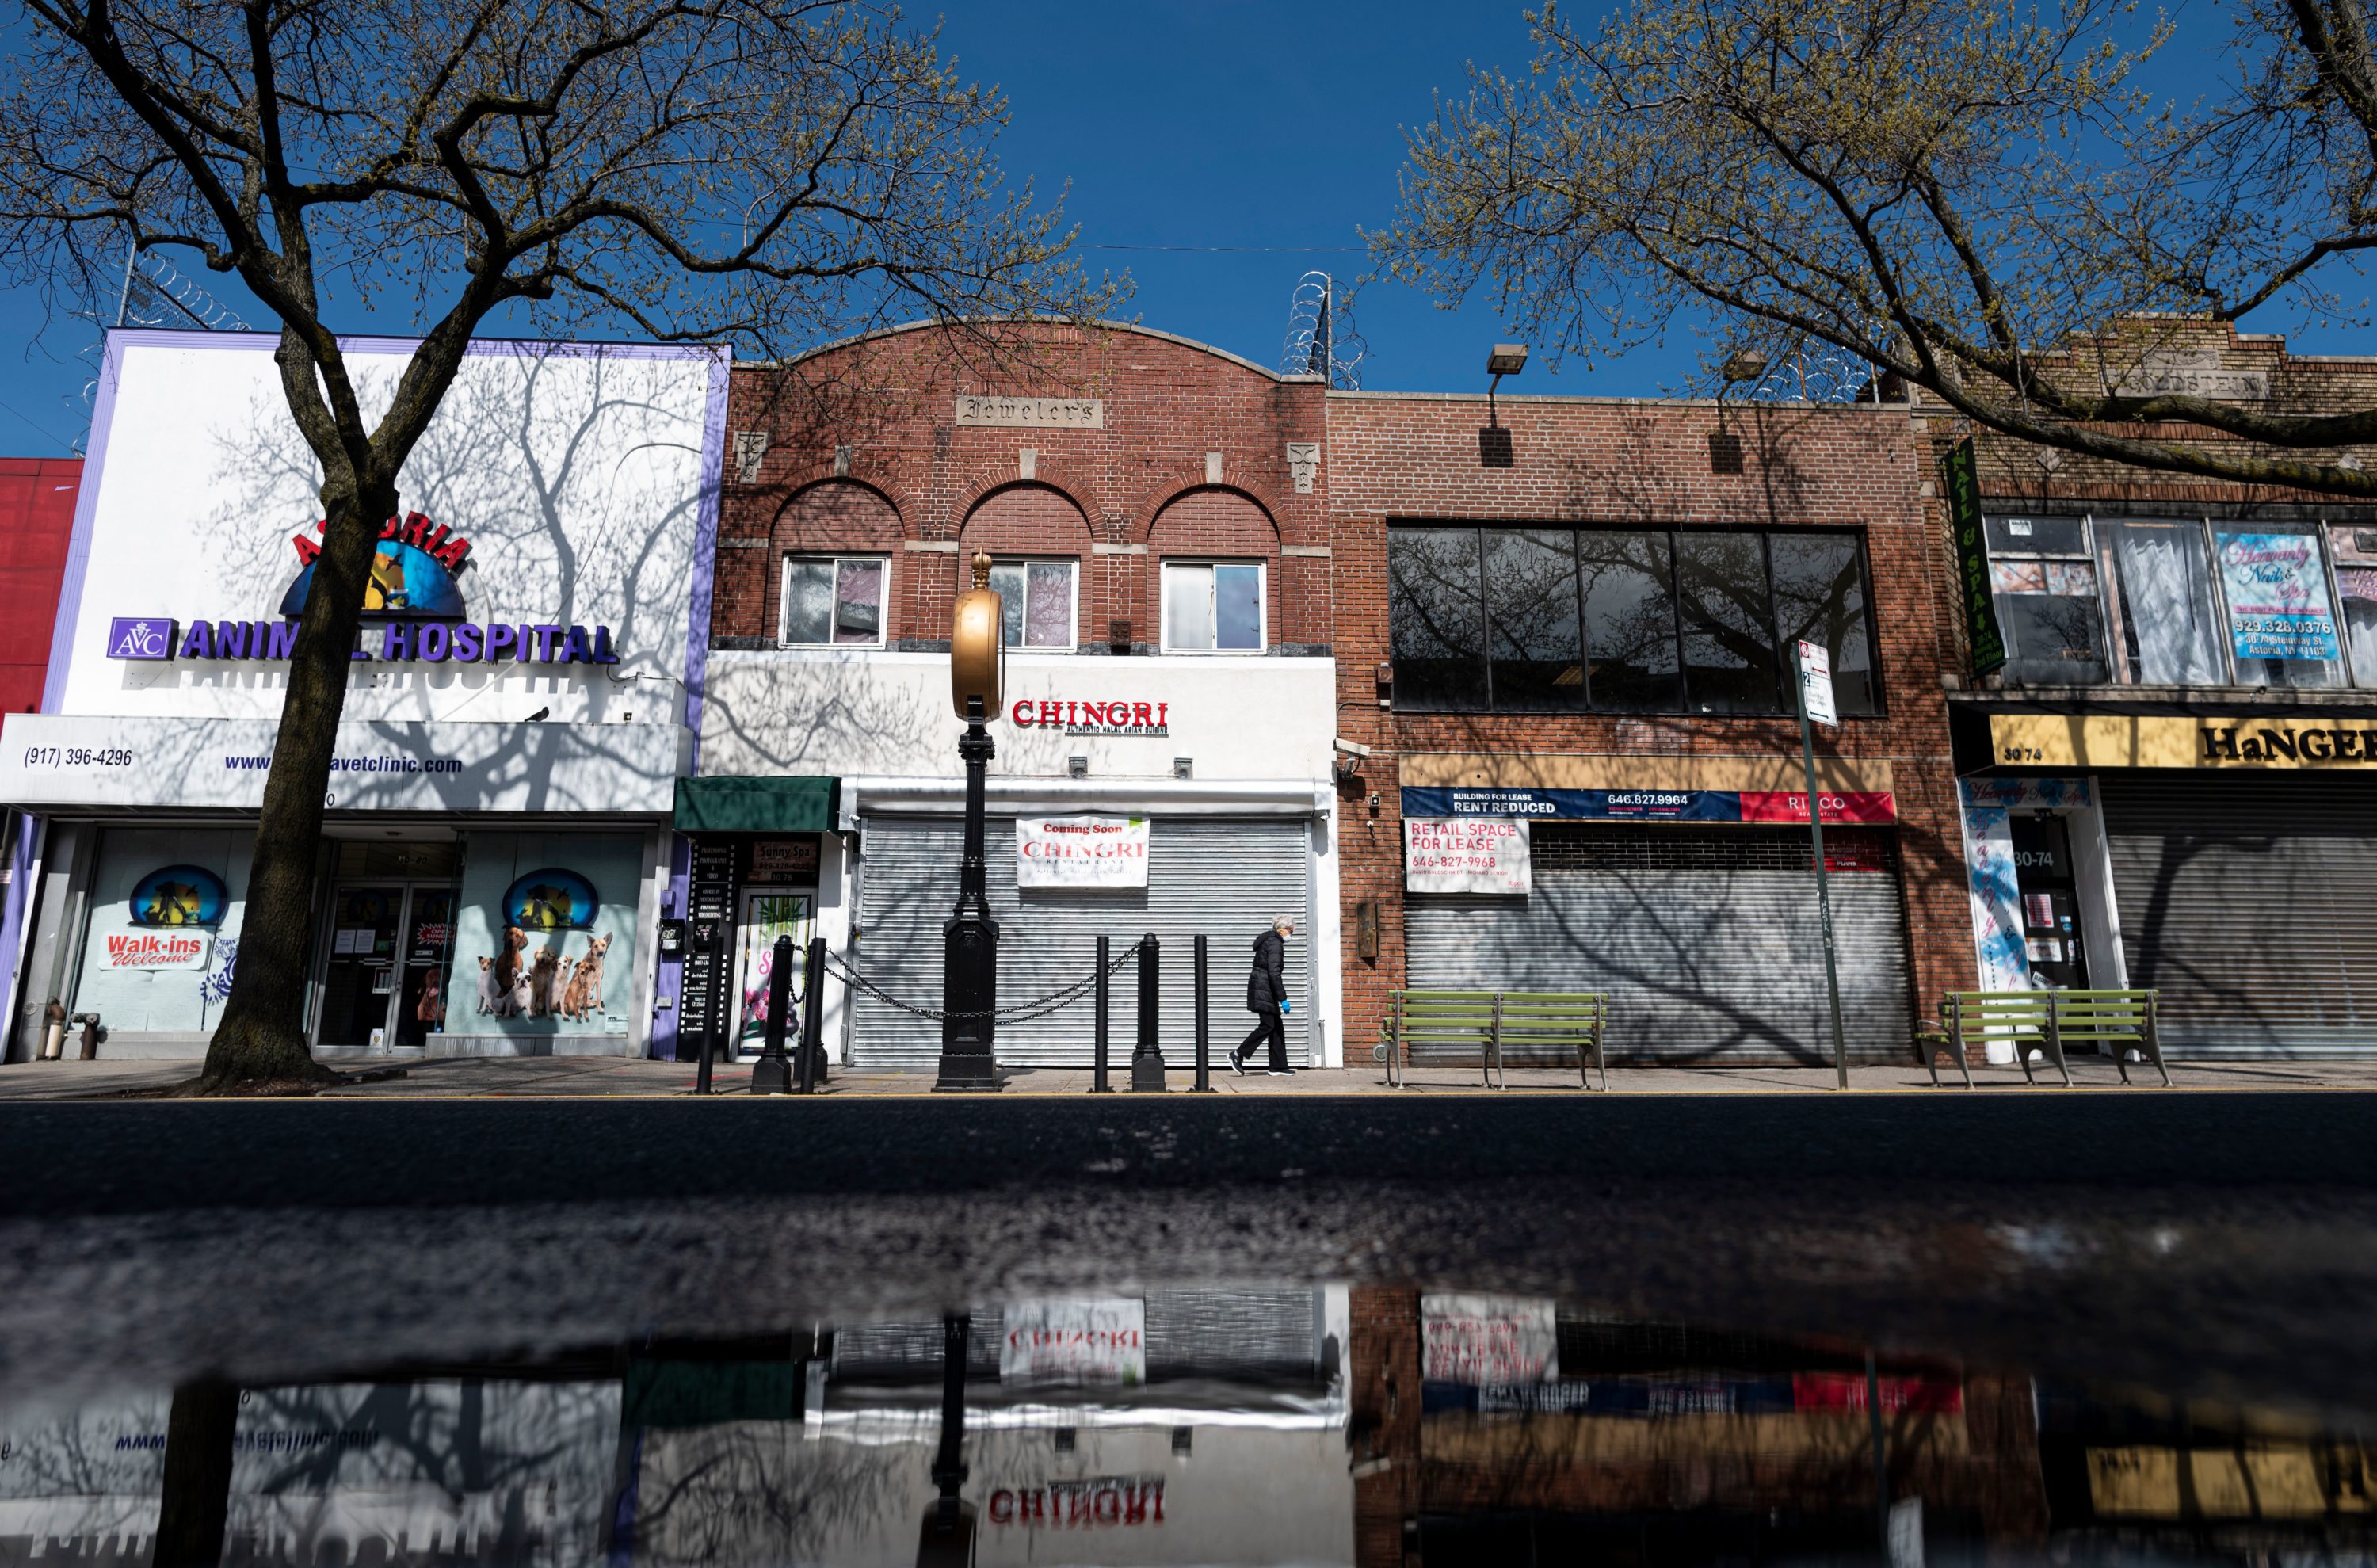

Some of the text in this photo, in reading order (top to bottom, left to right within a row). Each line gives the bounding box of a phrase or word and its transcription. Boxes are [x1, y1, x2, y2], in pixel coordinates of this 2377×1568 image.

[962, 399, 1093, 424] Jewelers
[1952, 449, 1973, 521] NAIL
[2225, 539, 2311, 570] Heavenly
[1967, 555, 1986, 612] SPA
[2276, 579, 2309, 607] Spa
[2234, 620, 2332, 635] 929.328.0376
[115, 628, 163, 655] AVC
[383, 622, 618, 664] HOSPITAL
[1013, 700, 1169, 727] CHINGRI
[25, 746, 132, 769] (917) 396-4296
[1453, 802, 1489, 812] RENT
[1492, 803, 1556, 814] REDUCED
[1608, 795, 1688, 805] 646.827.9964
[1043, 823, 1123, 835] Coming Soon
[1411, 822, 1517, 837] RETAIL SPACE
[760, 845, 810, 859] Sunny Spa
[1023, 841, 1145, 858] CHINGRI
[1411, 837, 1495, 851] FOR LEASE
[1412, 856, 1497, 868] 646-827-9968
[108, 935, 202, 953] Walk-ins
[110, 950, 195, 967] Welcome
